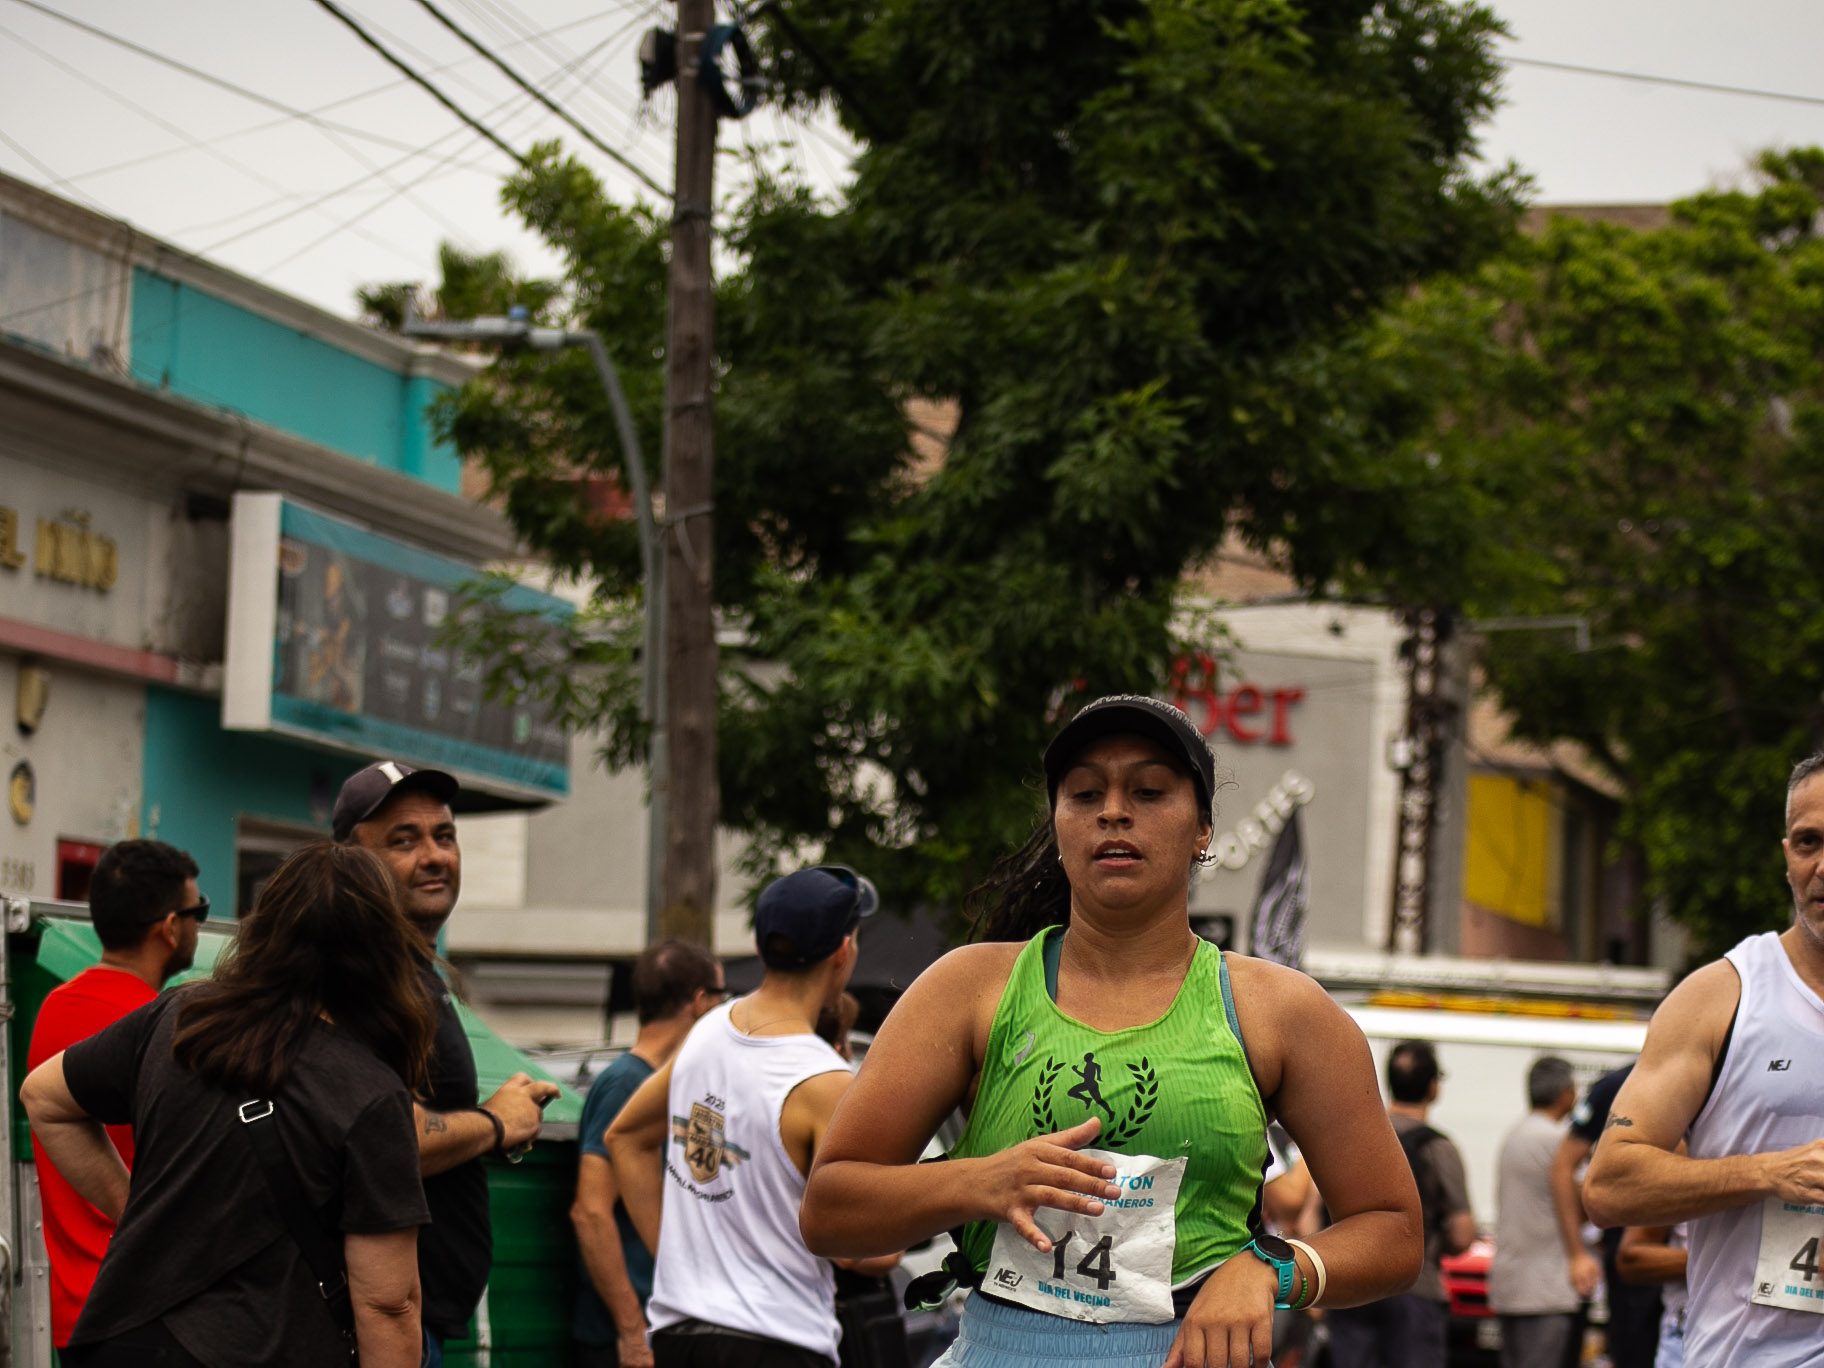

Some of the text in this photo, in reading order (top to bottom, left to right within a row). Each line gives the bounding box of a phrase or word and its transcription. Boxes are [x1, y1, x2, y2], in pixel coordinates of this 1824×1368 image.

[1767, 1059, 1793, 1072] NEJ
[1051, 1231, 1116, 1290] 14
[994, 1268, 1023, 1287] NEJ
[1074, 1290, 1110, 1307] VECINO
